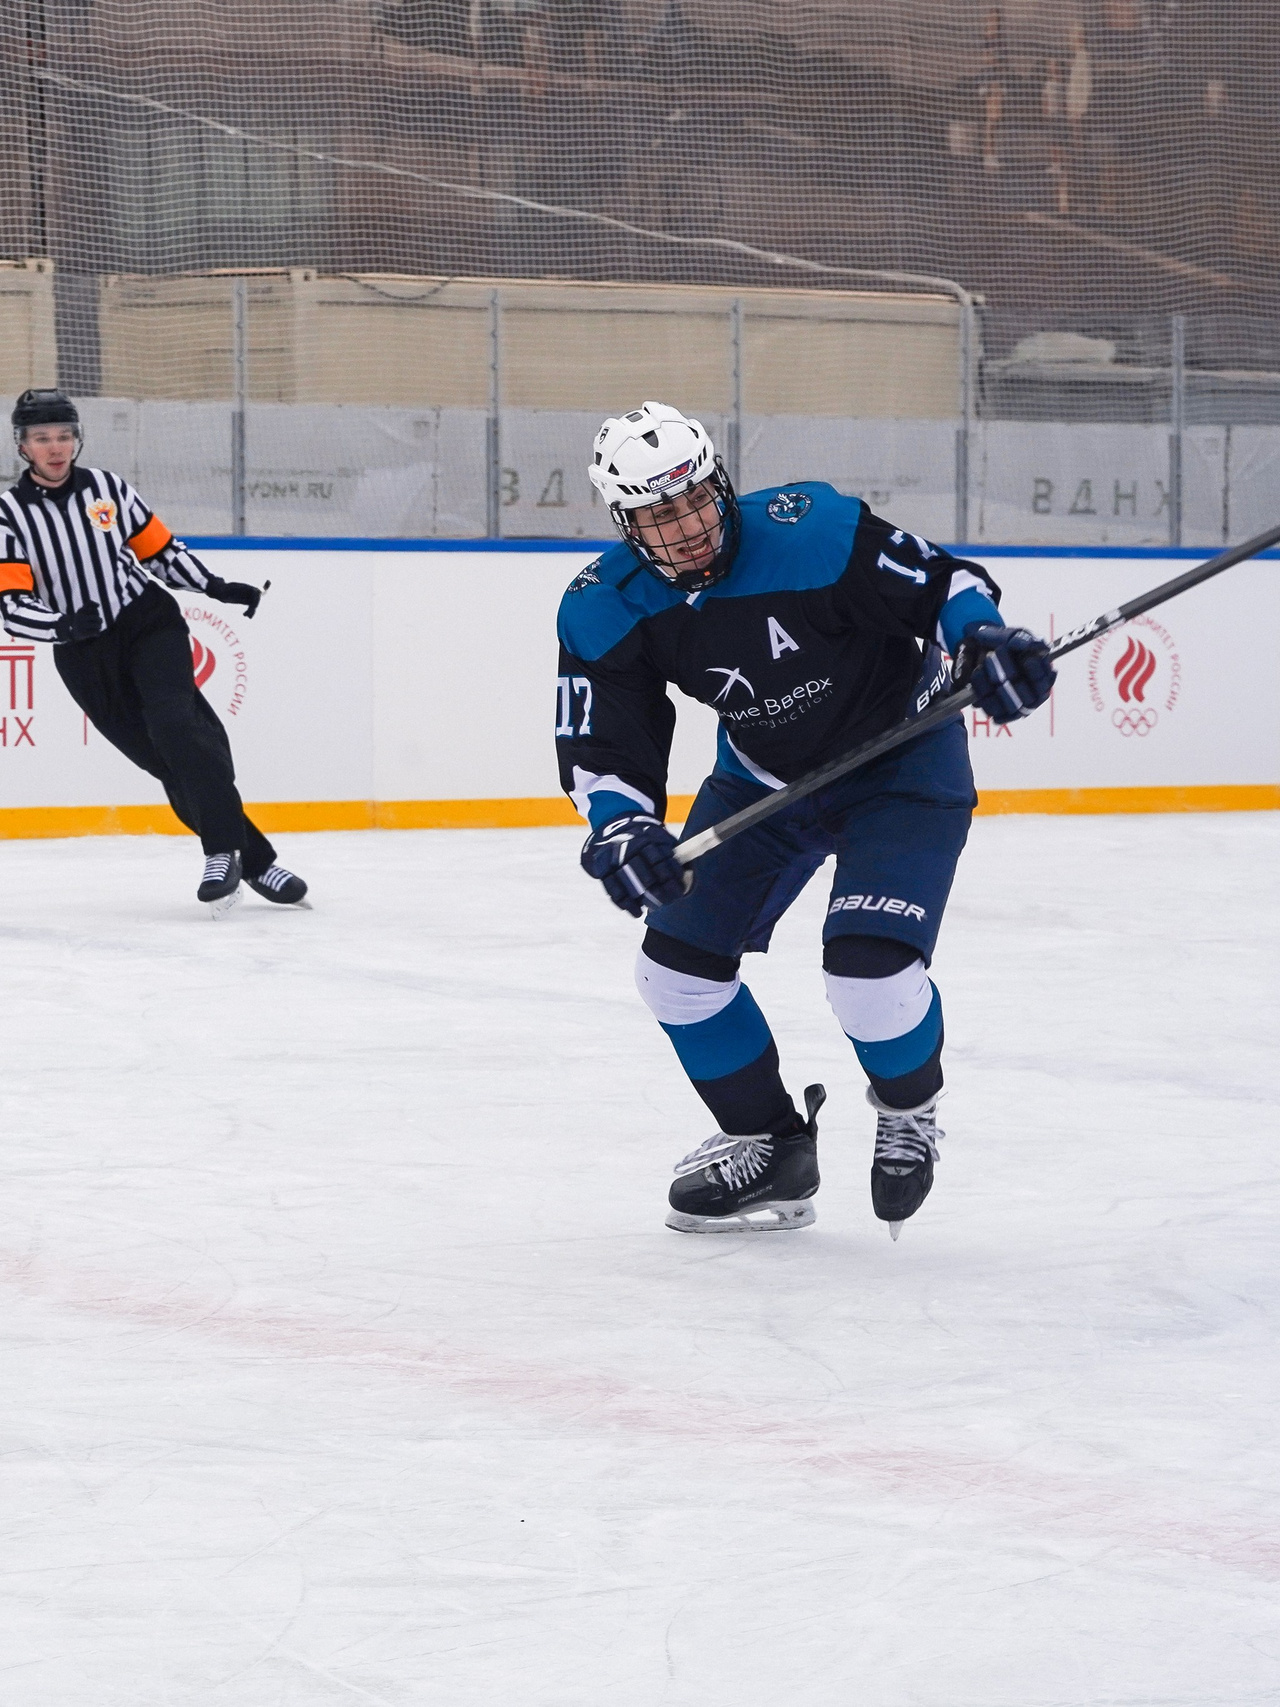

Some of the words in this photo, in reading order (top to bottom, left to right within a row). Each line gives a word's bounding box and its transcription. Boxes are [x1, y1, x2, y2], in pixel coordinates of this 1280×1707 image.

[767, 616, 801, 660] A
[227, 651, 248, 716] РОССИИ
[556, 676, 592, 737] 17
[764, 677, 833, 716] Вверх
